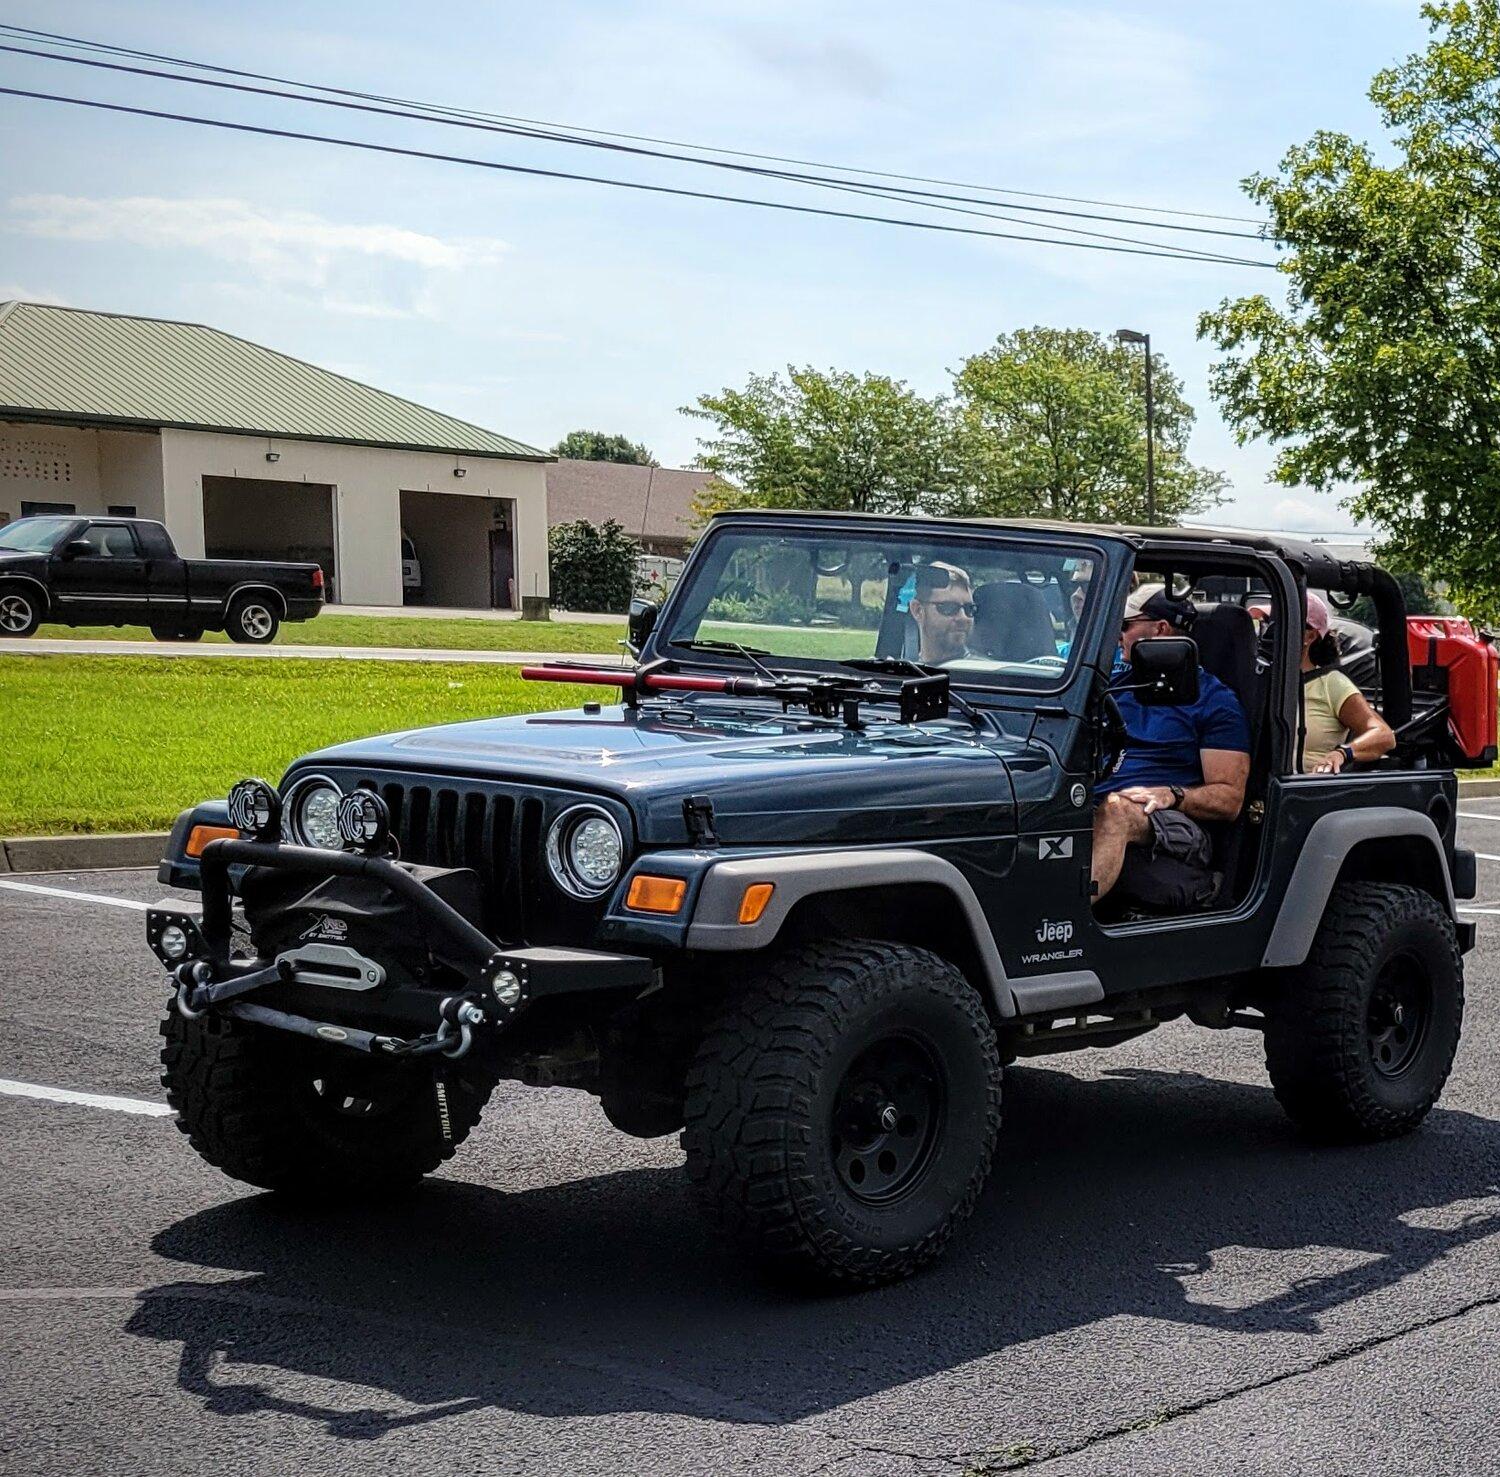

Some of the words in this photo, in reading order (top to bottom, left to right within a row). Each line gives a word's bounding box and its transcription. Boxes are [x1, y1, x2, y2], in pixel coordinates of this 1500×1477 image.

[228, 787, 255, 829] KC
[336, 797, 363, 841] KC
[1036, 919, 1073, 943] Jeep
[1021, 948, 1084, 964] WRANGLER
